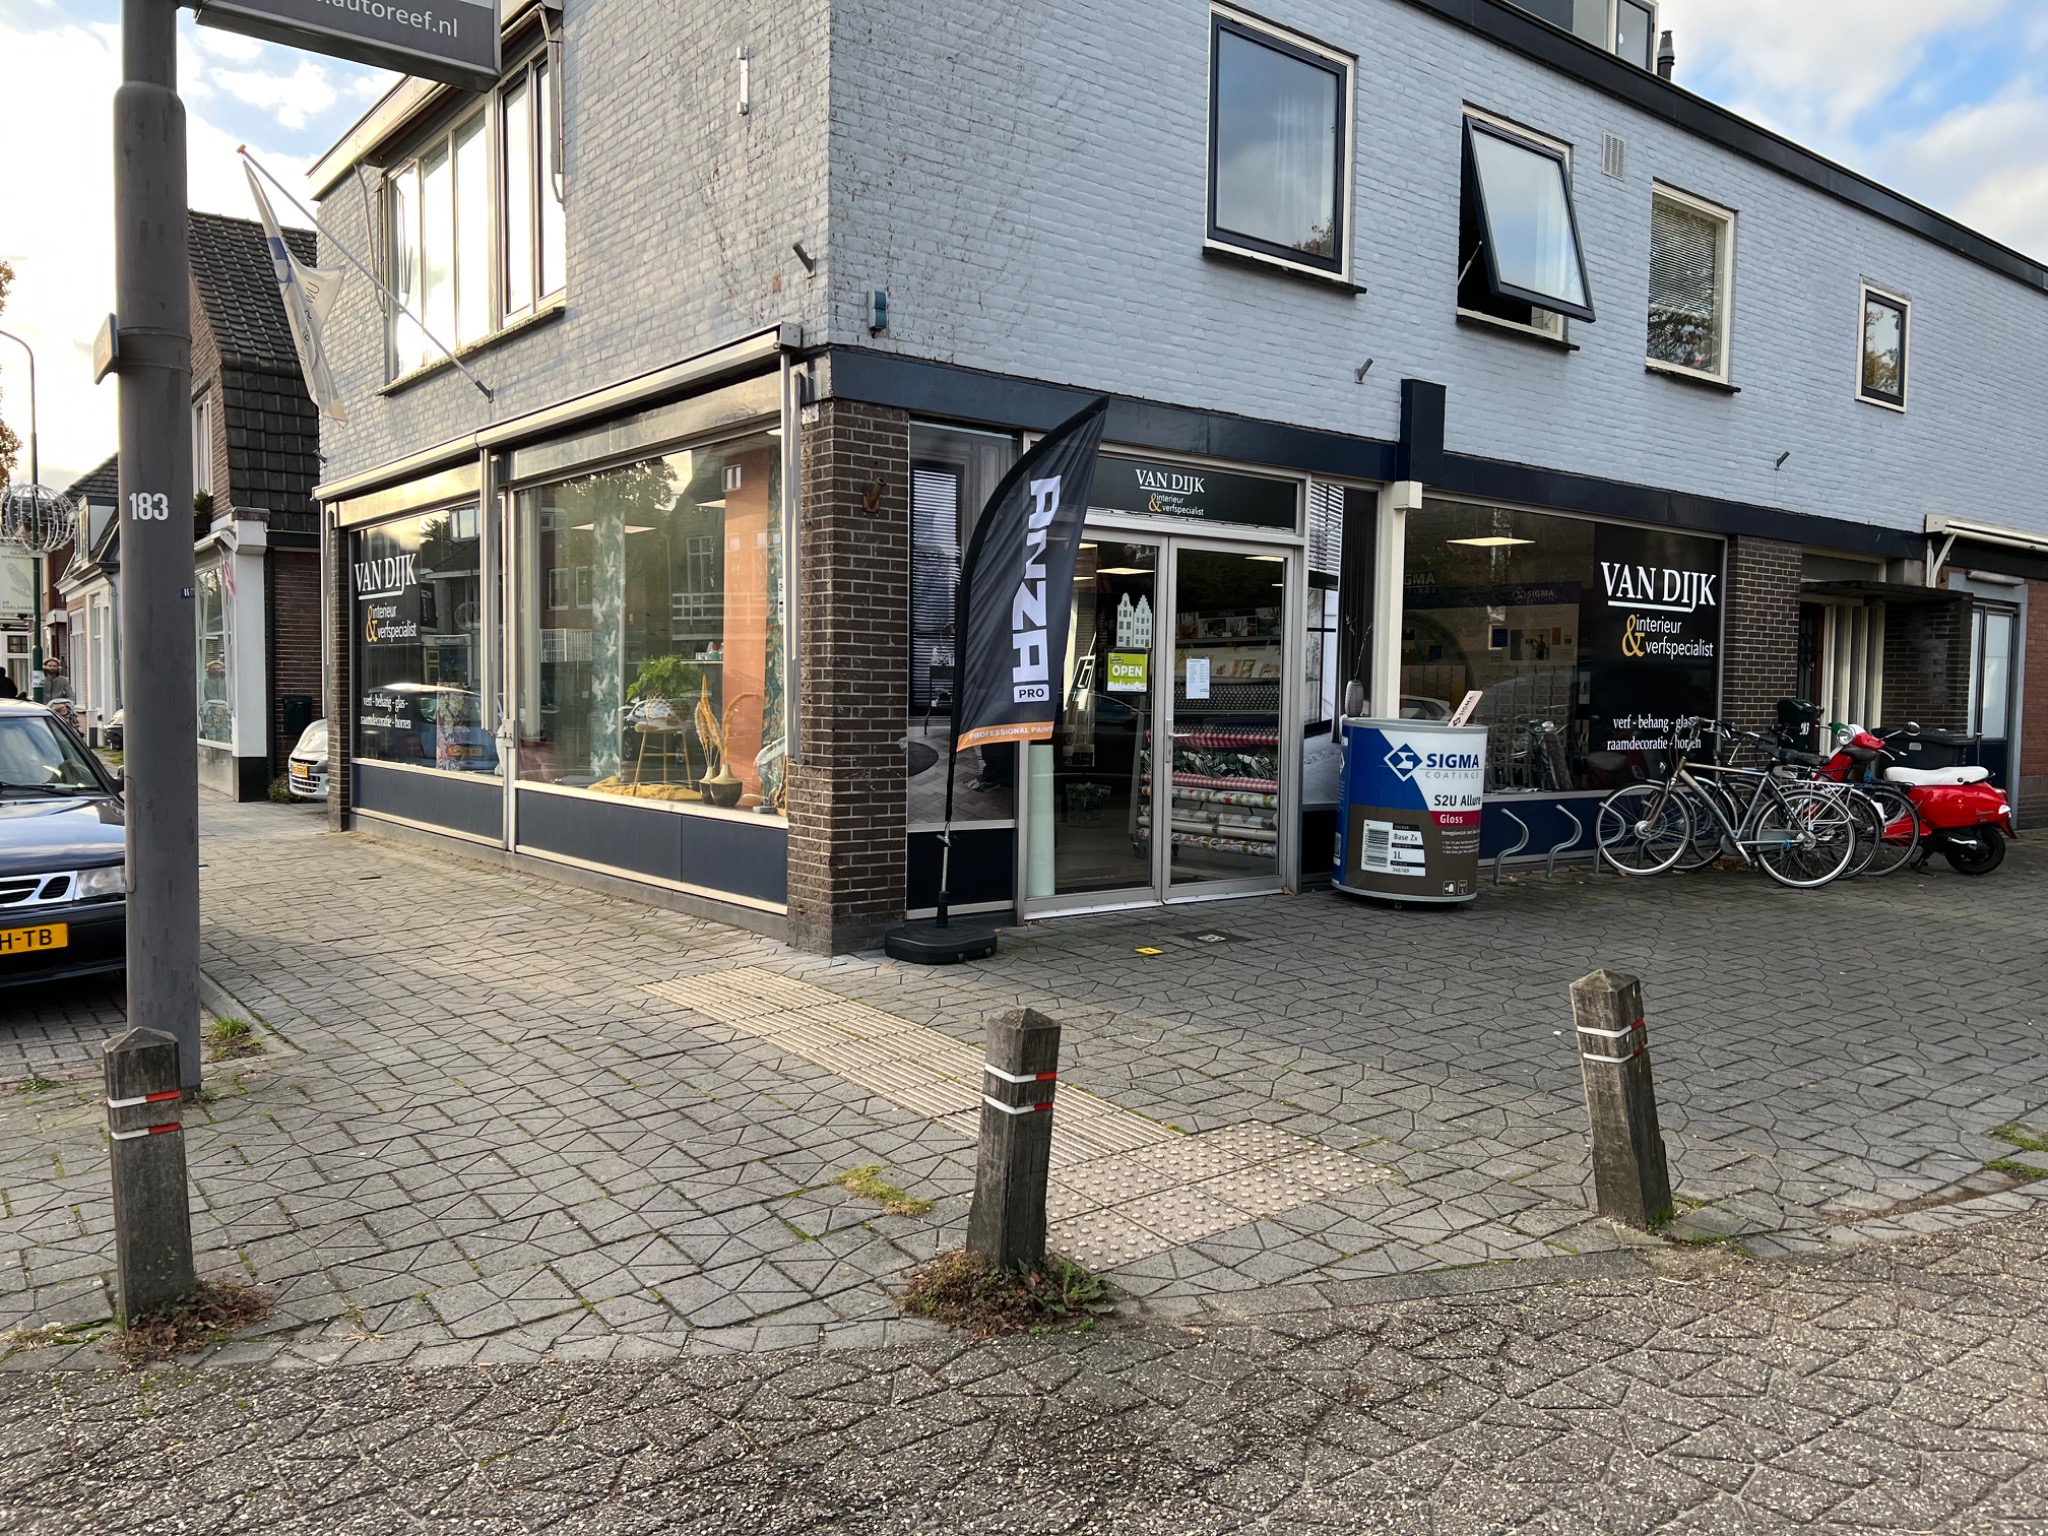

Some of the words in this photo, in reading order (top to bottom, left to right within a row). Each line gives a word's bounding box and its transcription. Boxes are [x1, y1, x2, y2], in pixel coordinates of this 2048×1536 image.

[317, 0, 458, 38] .autoreef.nl
[1135, 469, 1168, 488] VAN
[1171, 473, 1205, 495] DIJK
[1156, 492, 1184, 504] interieur
[129, 492, 169, 521] 183
[1161, 503, 1204, 516] verfspecialist
[354, 559, 382, 592] VAN
[384, 553, 417, 595] DIJK
[1012, 475, 1061, 683] ANZA
[1600, 561, 1656, 601] VAN
[1662, 568, 1717, 613] DIJK
[372, 602, 397, 618] interieur
[377, 619, 417, 642] verfspecialist
[1621, 614, 1646, 657] &
[1635, 614, 1682, 634] interieur
[1645, 635, 1714, 660] verfspecialist
[1112, 665, 1143, 677] OPEN
[1018, 688, 1045, 699] PRO
[1613, 714, 1632, 729] verf
[1638, 713, 1669, 733] behang
[969, 727, 1029, 740] PROFESSIONAL
[1606, 736, 1668, 751] raamdecoratie
[1426, 753, 1479, 769] SIGMA
[1425, 771, 1479, 779] COATINGS
[1434, 794, 1457, 807] S2U
[1460, 794, 1481, 807] Allure
[1439, 814, 1464, 824] Gloss
[1394, 833, 1409, 841] Base
[1393, 851, 1402, 860] 1L
